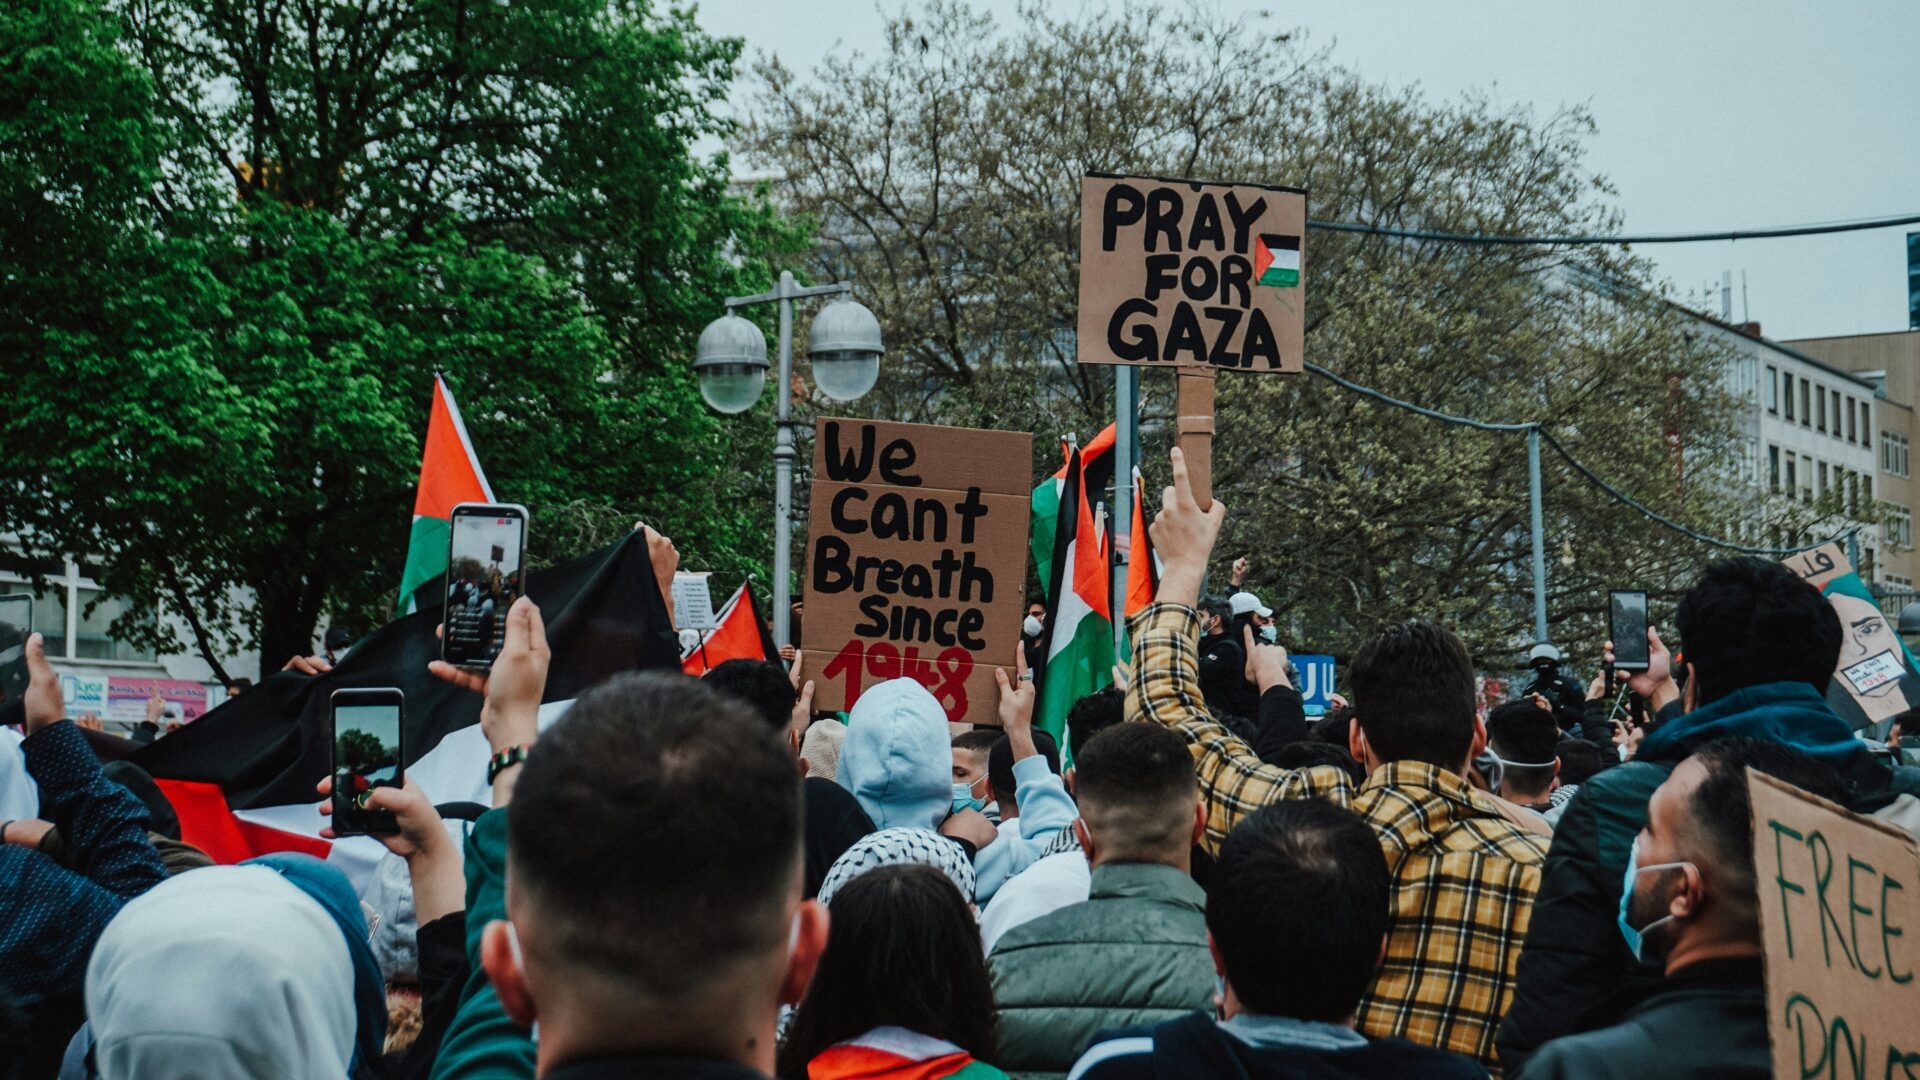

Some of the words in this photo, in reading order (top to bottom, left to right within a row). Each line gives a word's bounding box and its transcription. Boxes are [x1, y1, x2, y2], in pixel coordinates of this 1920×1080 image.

[1103, 184, 1267, 254] PRAY
[1145, 254, 1253, 309] FOR
[1107, 298, 1282, 369] GAZA
[824, 421, 923, 486] We
[813, 535, 994, 603] Breath
[1768, 818, 1914, 984] FREE
